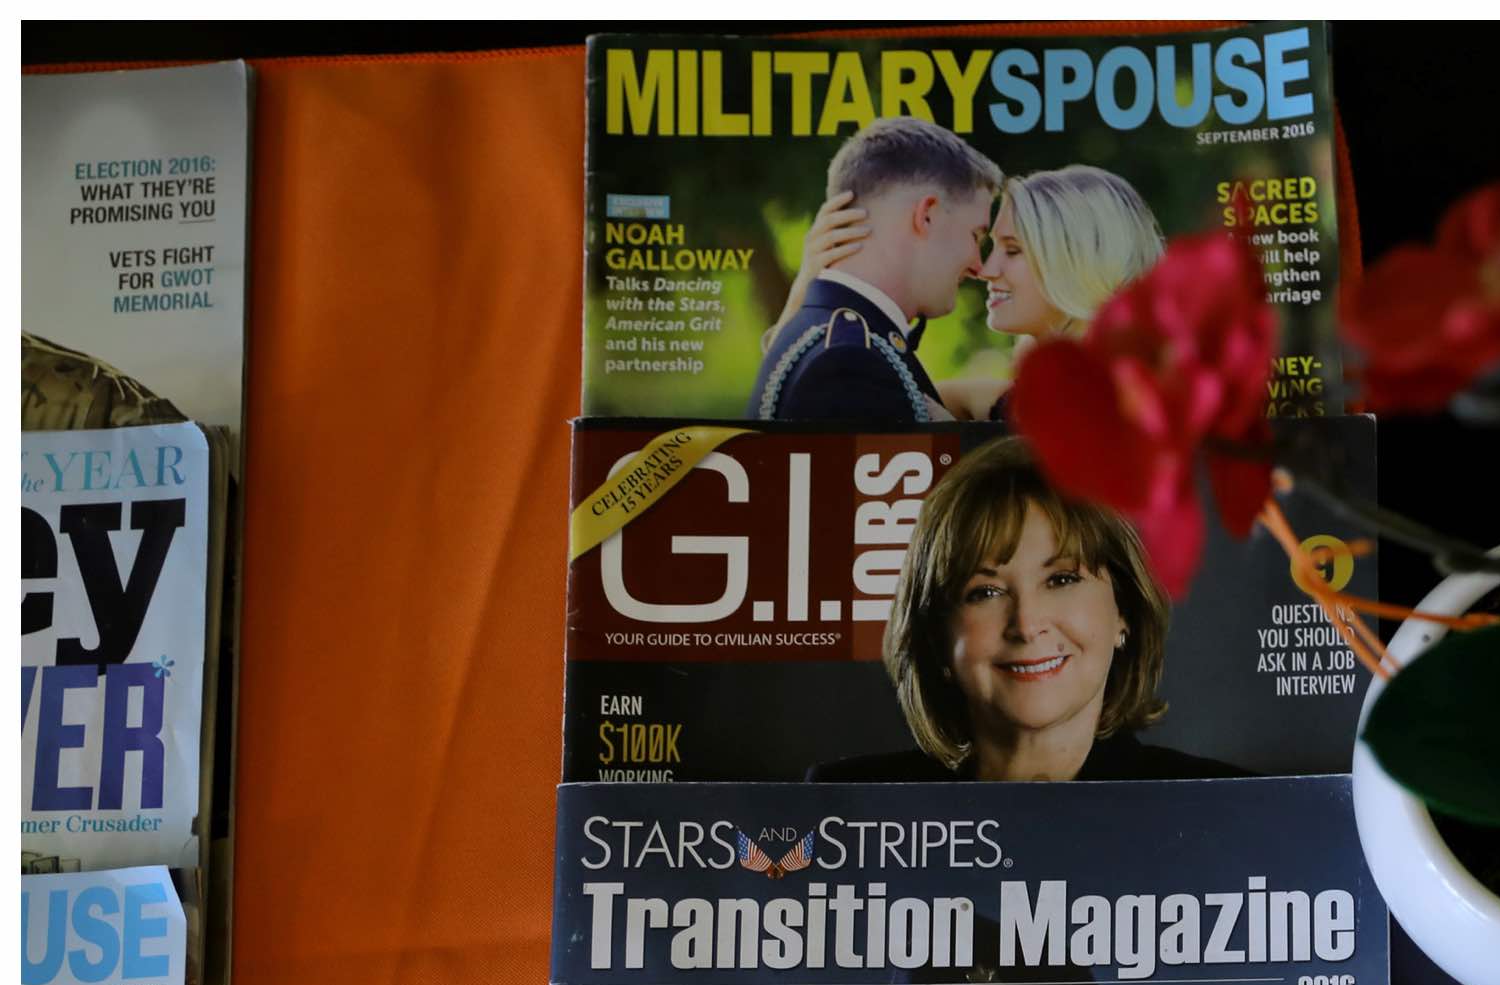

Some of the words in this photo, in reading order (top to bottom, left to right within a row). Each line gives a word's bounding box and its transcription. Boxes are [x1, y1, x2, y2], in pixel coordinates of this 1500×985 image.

[1196, 126, 1278, 147] SEPTEMBER
[1282, 121, 1315, 139] 2016
[75, 159, 162, 180] ELECTION
[168, 156, 216, 175] 2016:
[81, 179, 134, 202] WHAT
[141, 177, 216, 199] THEY'RE
[70, 202, 174, 225] PROMISING
[179, 199, 216, 219] YOU
[605, 223, 685, 246] NOAH
[109, 248, 156, 269] VETS
[162, 246, 214, 266] FIGHT
[606, 248, 754, 271] GALLOWAY
[118, 271, 154, 290] FOR
[161, 268, 214, 288] GWOT
[606, 277, 649, 292] Talks
[654, 277, 722, 296] Dancing
[113, 291, 213, 314] MEMORIAL
[606, 315, 682, 331] American
[688, 315, 722, 333] Grit
[43, 445, 186, 493] YEAR
[591, 430, 692, 517] CELEBRATING
[633, 456, 683, 502] YEARS
[606, 633, 644, 646] YOUR
[647, 633, 690, 646] GUIDE
[695, 634, 712, 646] TO
[715, 633, 772, 646] CIVILIAN
[1257, 629, 1289, 649] YOU
[1277, 674, 1355, 696] INTERVIEW
[601, 696, 642, 715] EARN
[599, 720, 682, 764] $100K
[66, 815, 162, 833] Crusader
[581, 816, 735, 870] STARS
[758, 827, 797, 842] AND
[583, 881, 974, 970] Transition
[1001, 876, 1356, 979] Magazine
